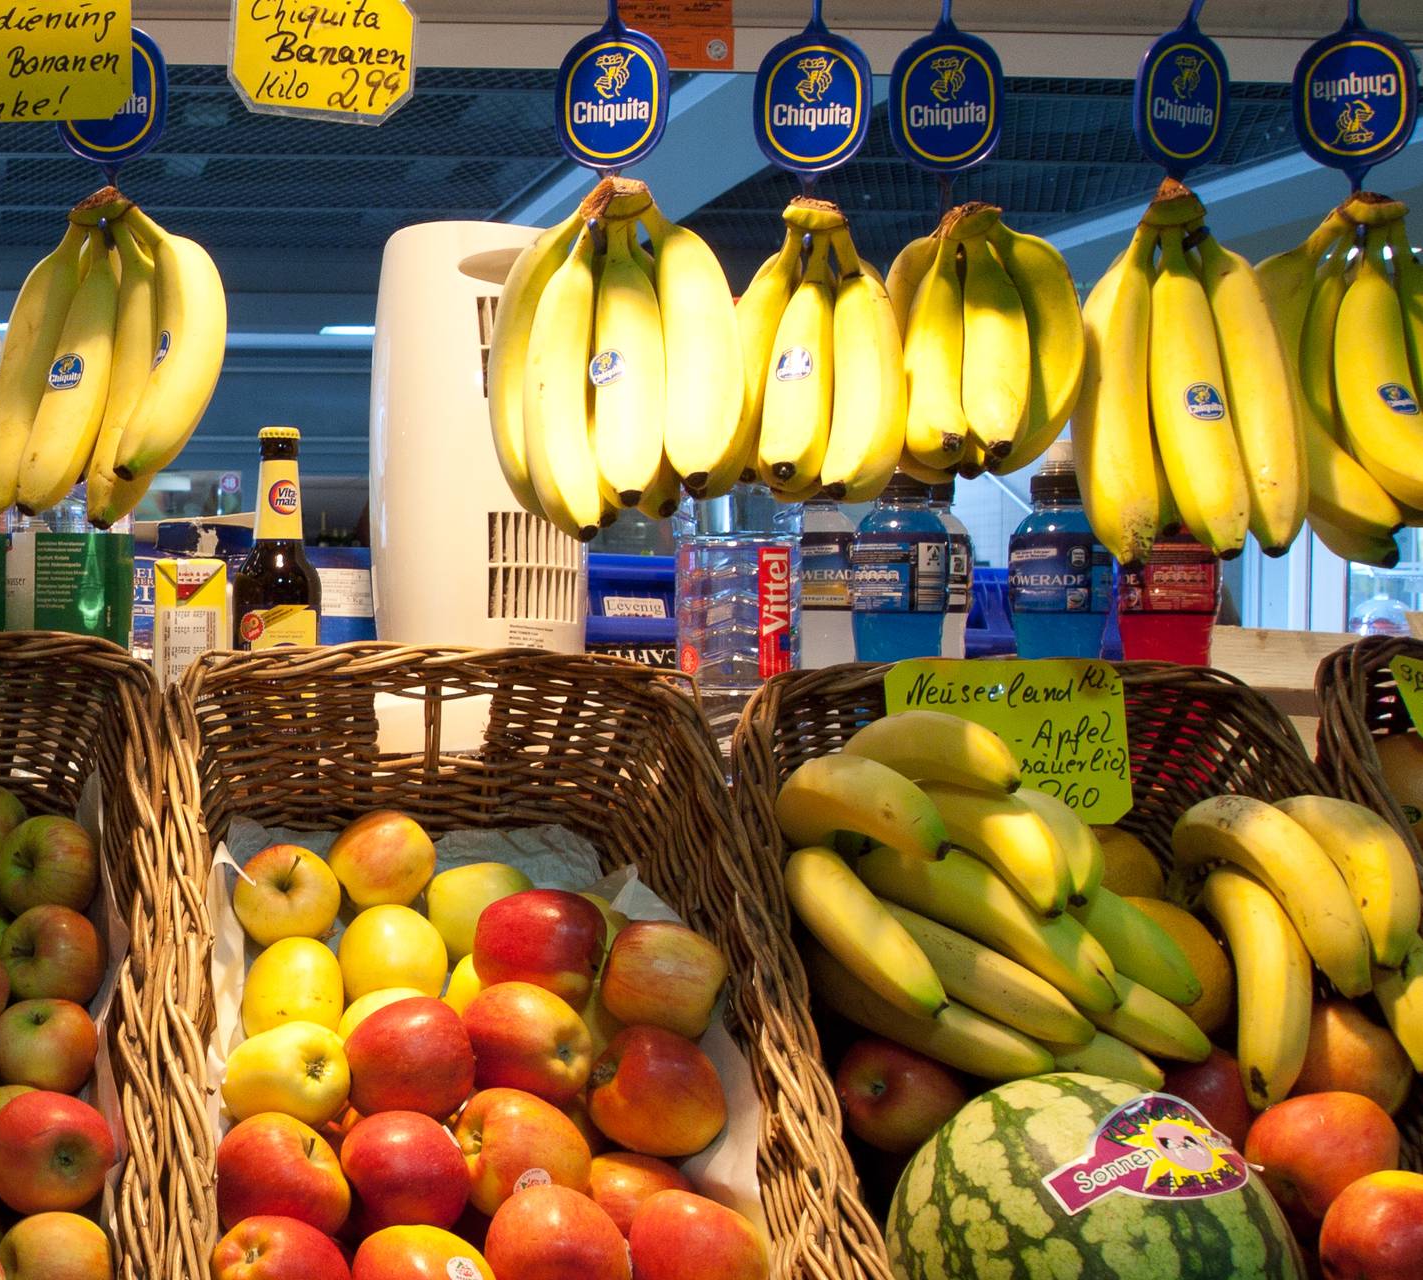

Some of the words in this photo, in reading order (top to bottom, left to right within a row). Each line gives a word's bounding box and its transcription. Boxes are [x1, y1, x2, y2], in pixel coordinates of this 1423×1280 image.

[251, 0, 380, 38] Chiquita
[7, 46, 120, 78] Bananen
[265, 31, 406, 71] Bananen
[256, 69, 309, 99] Kilo
[1313, 74, 1397, 101] Chiquita
[573, 98, 649, 127] Chiquita
[772, 102, 852, 129] Chiquita
[909, 102, 987, 130] Chiquita
[1152, 96, 1215, 127] Chiquita
[607, 600, 663, 615] Levenig
[763, 552, 790, 636] Vittel
[1032, 711, 1114, 760] Apfel
[1074, 1148, 1162, 1192] Sonnen
